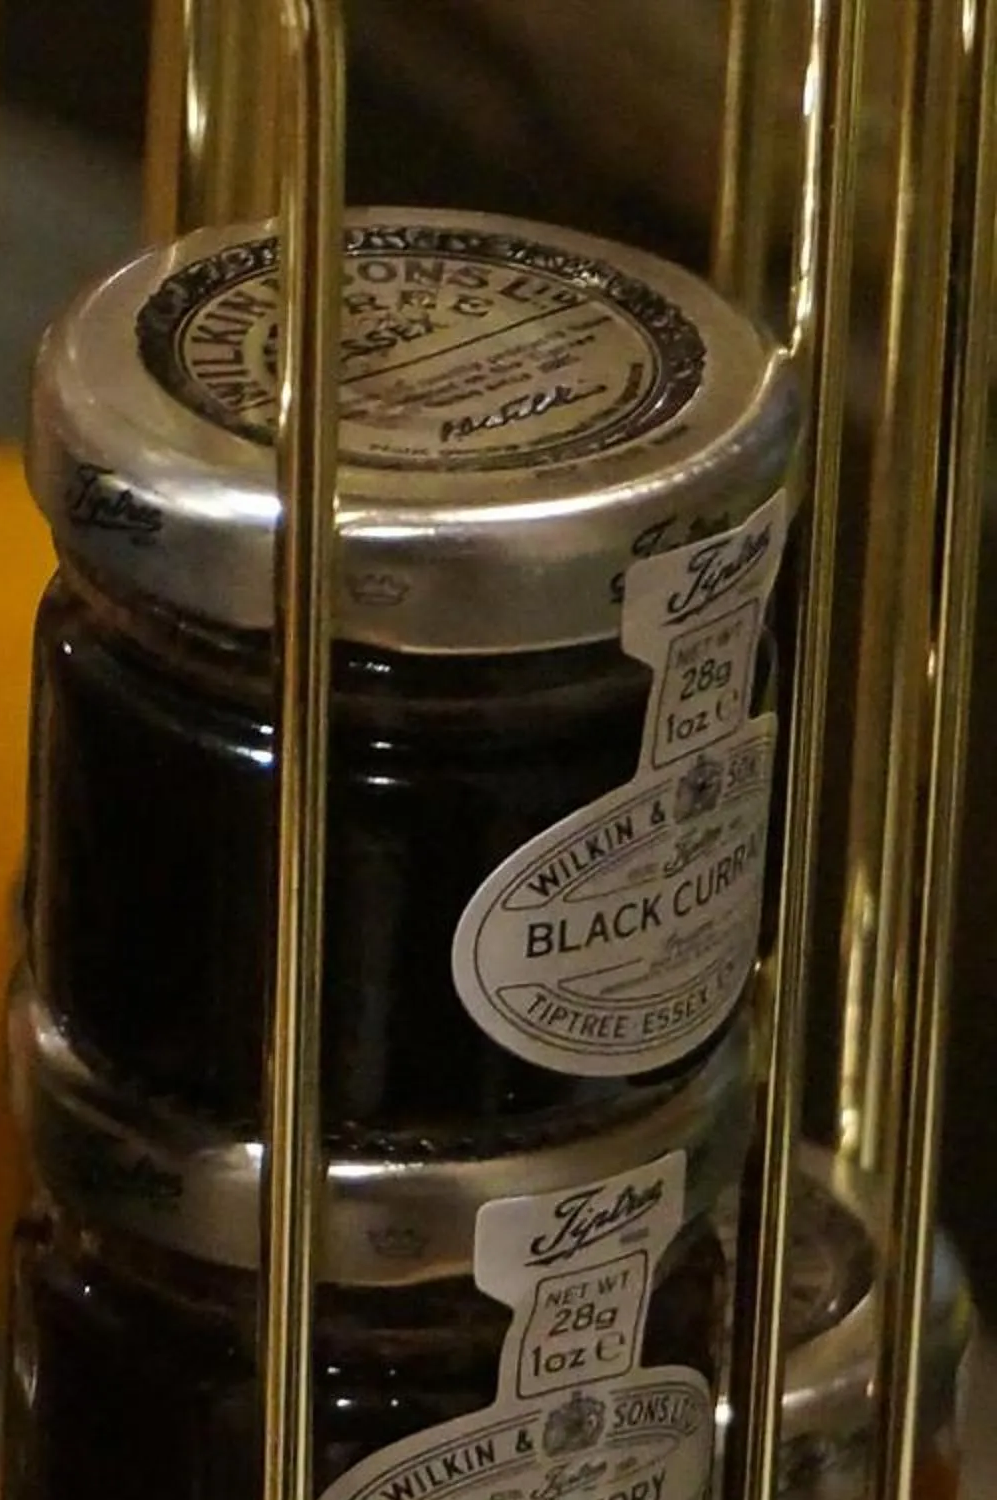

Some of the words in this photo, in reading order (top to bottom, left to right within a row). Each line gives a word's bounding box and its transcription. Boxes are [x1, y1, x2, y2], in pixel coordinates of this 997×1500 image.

[341, 258, 493, 290] ONS
[340, 316, 449, 363] SSEX
[680, 659, 732, 701] 28g
[527, 815, 635, 898] WILKIN
[525, 894, 663, 959] BLACK
[526, 992, 629, 1039] TIPTREE
[525, 1179, 665, 1267] Tiptree
[547, 1304, 619, 1338] 28g
[531, 1347, 586, 1378] 1oz
[515, 1429, 534, 1454] &
